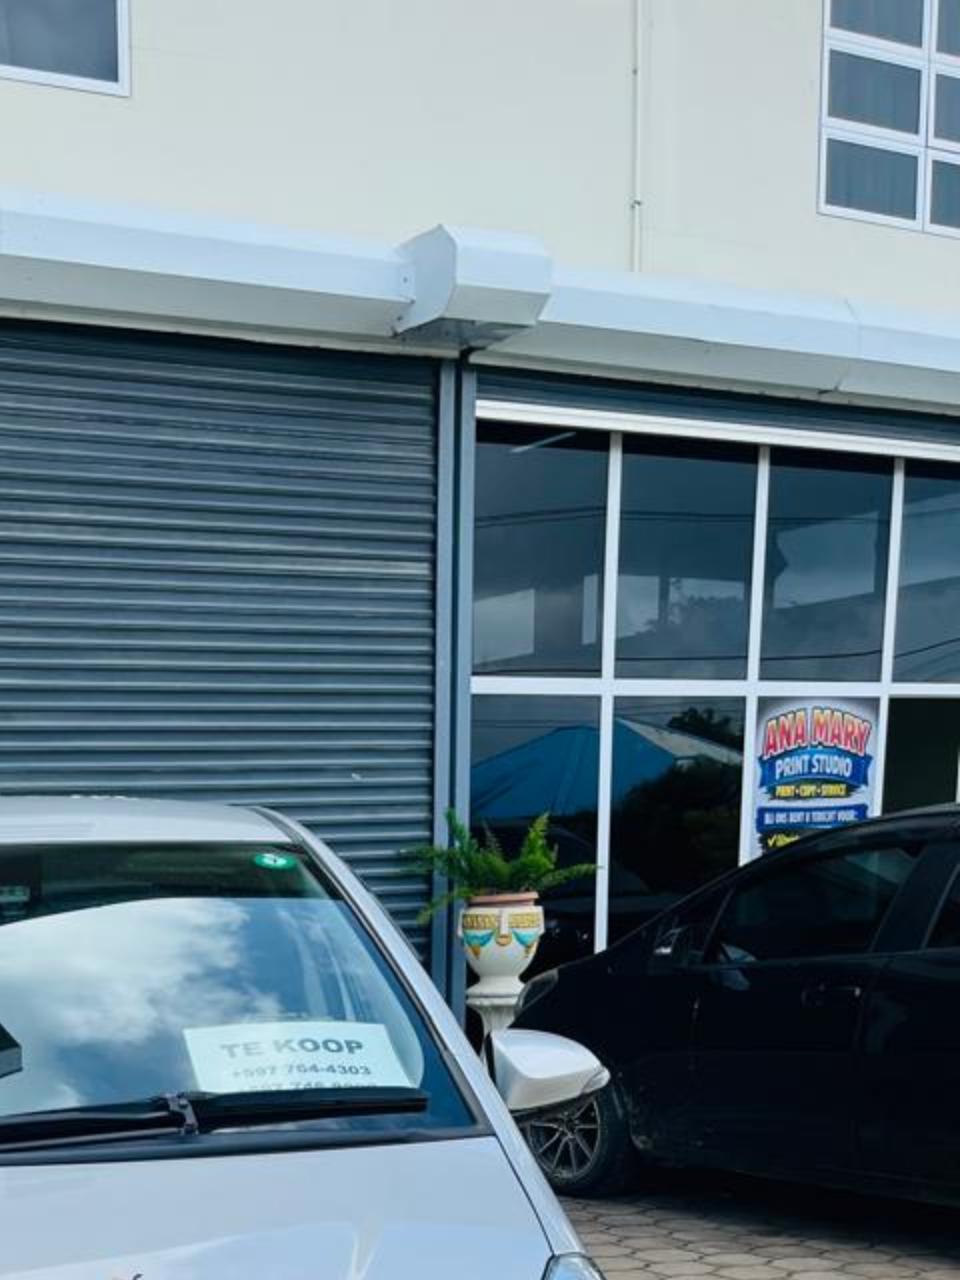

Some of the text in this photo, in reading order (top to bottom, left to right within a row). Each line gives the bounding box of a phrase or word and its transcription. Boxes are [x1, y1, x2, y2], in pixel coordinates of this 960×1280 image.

[763, 706, 872, 760] ANA MARY
[775, 754, 853, 779] PRINT STUDIO
[219, 1037, 365, 1059] TE KOOP
